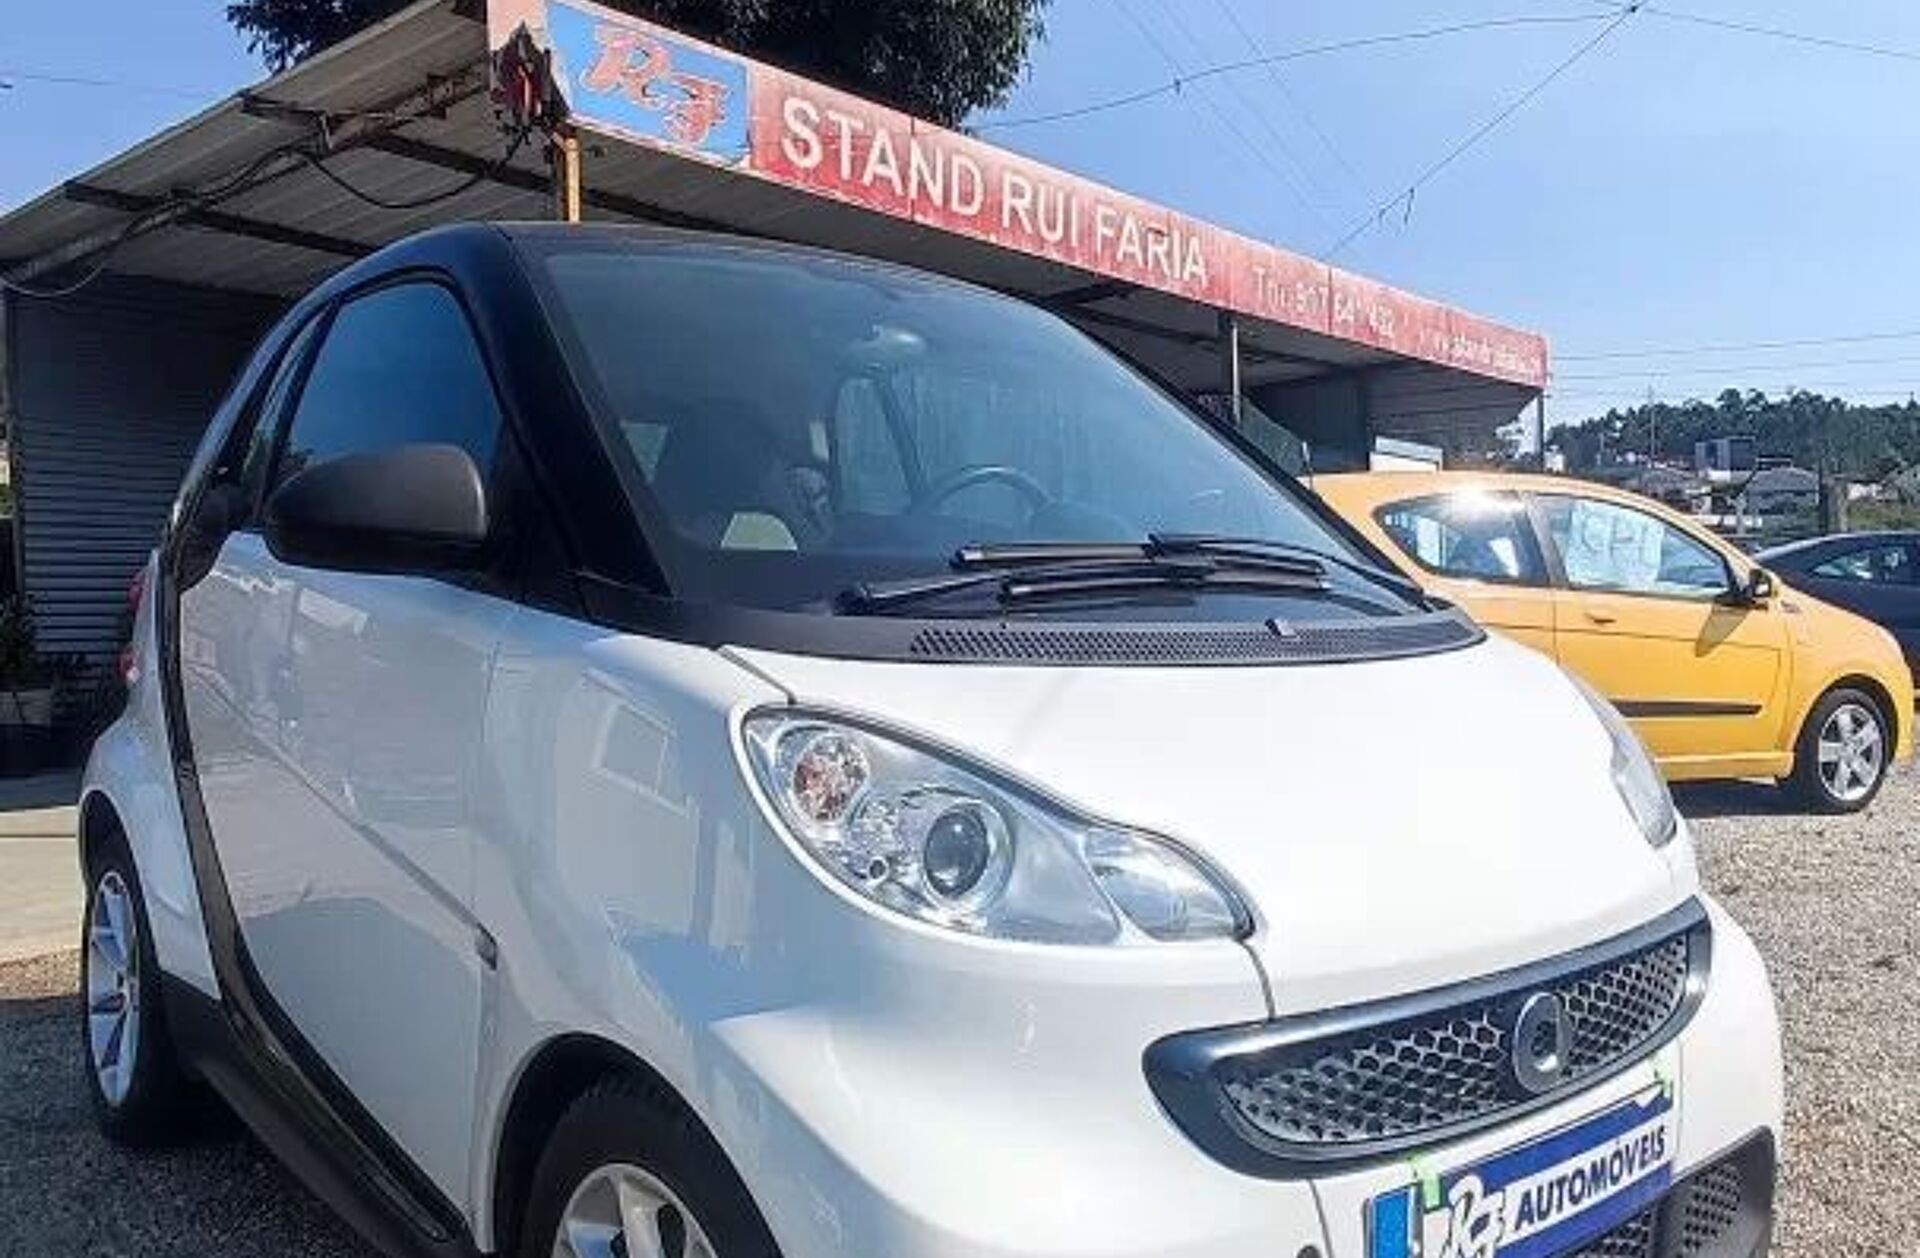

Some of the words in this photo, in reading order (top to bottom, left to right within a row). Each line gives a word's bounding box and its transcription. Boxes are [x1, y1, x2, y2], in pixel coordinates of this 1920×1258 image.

[782, 97, 985, 217] STAND
[1002, 170, 1078, 247] RUI
[1096, 203, 1207, 290] FARIA
[1514, 1124, 1667, 1232] AUTOMÓVEIS
